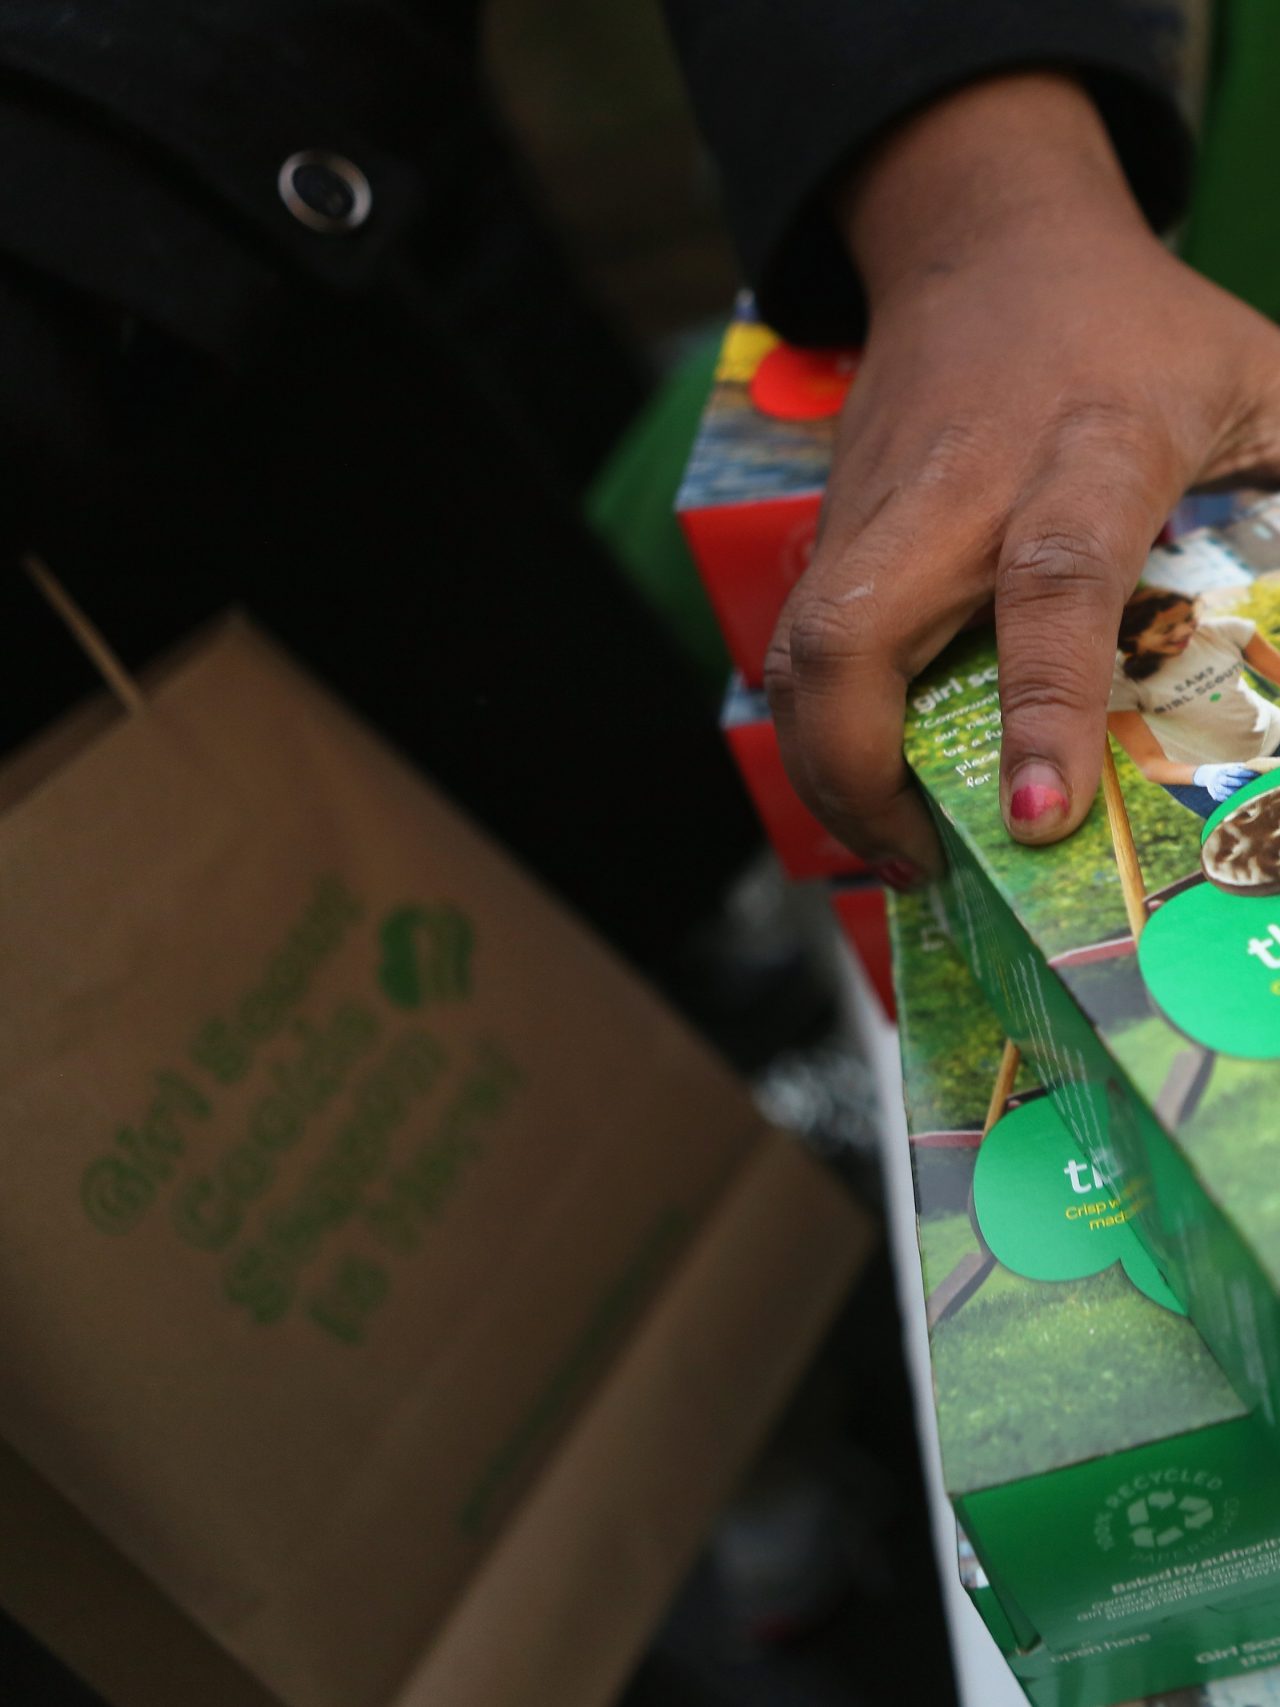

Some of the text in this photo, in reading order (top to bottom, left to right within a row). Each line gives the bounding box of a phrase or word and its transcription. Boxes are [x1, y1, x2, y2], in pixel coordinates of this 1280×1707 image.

[913, 677, 963, 715] girl
[80, 1066, 213, 1237] Girl
[1065, 1200, 1107, 1220] Crisp
[1089, 1210, 1126, 1231] mad
[1105, 1468, 1223, 1509] RECYCLED
[1111, 1568, 1172, 1594] Baked
[1173, 1560, 1198, 1577] by
[1049, 1629, 1151, 1666] open here
[1195, 1644, 1238, 1666] Girl
